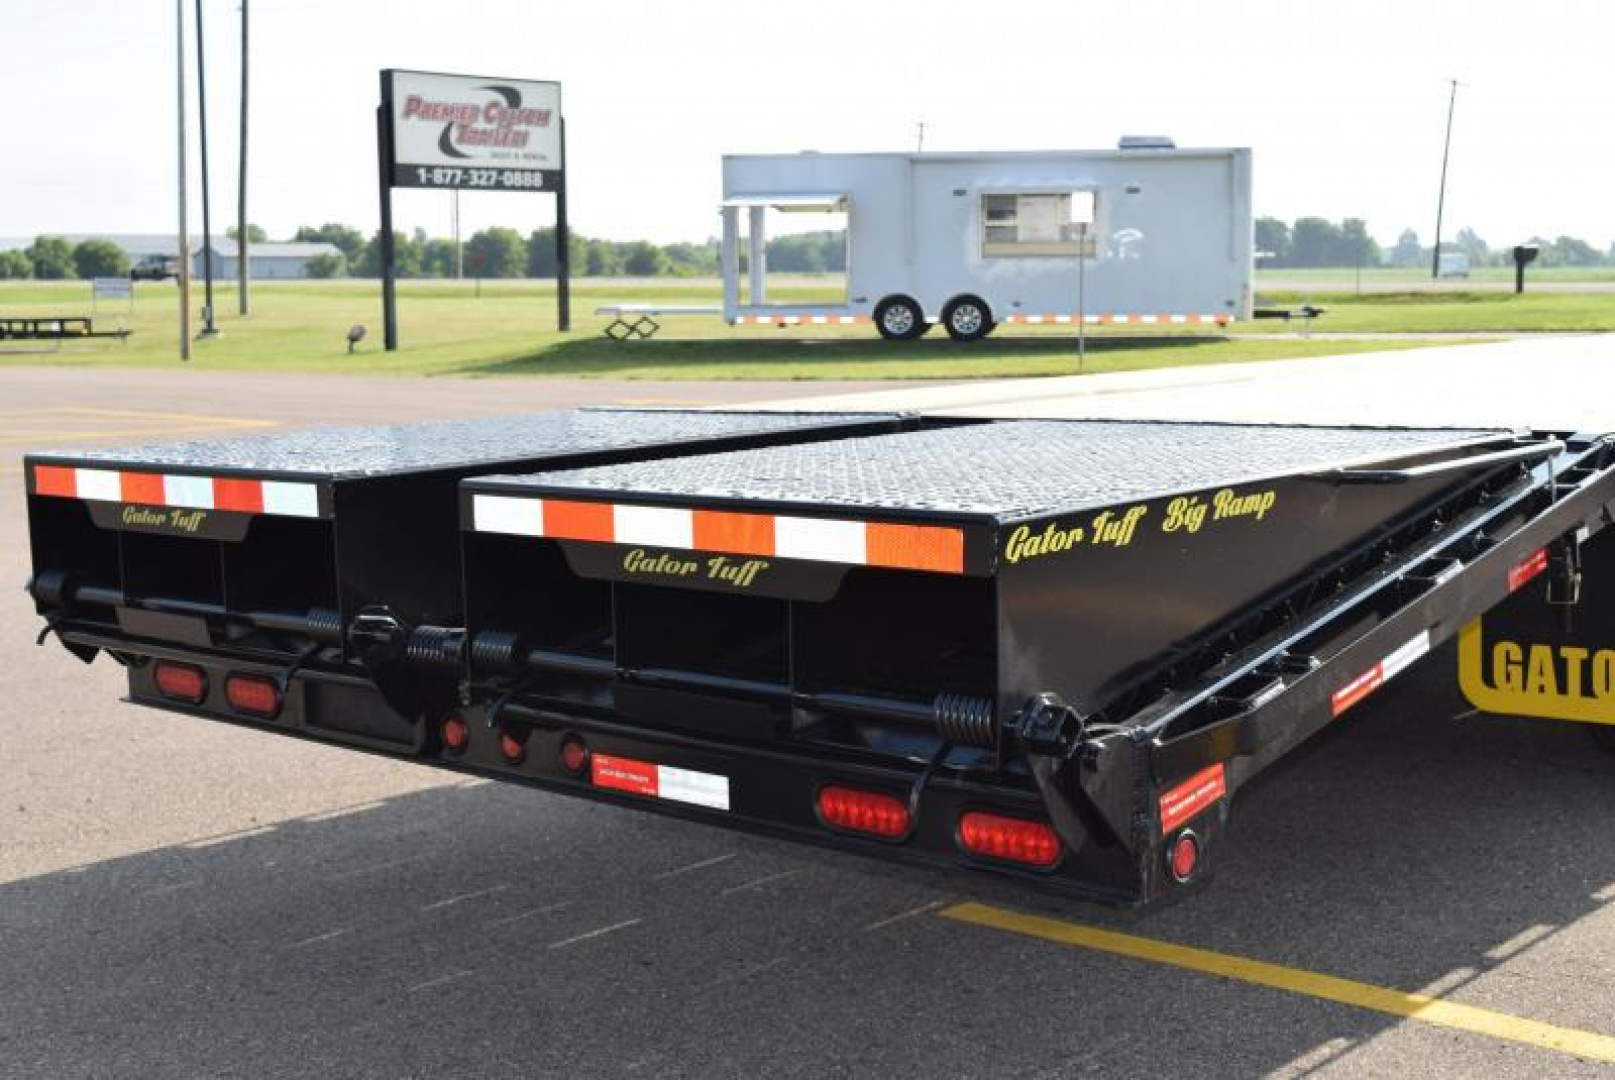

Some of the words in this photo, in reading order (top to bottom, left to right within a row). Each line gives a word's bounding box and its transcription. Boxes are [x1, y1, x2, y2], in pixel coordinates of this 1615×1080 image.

[122, 506, 167, 525] Gator
[170, 509, 207, 531] Tuff
[1005, 524, 1084, 563] Gator
[1091, 505, 1148, 546] Tuff
[1162, 496, 1208, 533] Big
[1212, 488, 1276, 521] Ramp
[623, 549, 698, 575] Gator
[708, 556, 770, 586] Tuff
[1493, 641, 1615, 698] GATO
